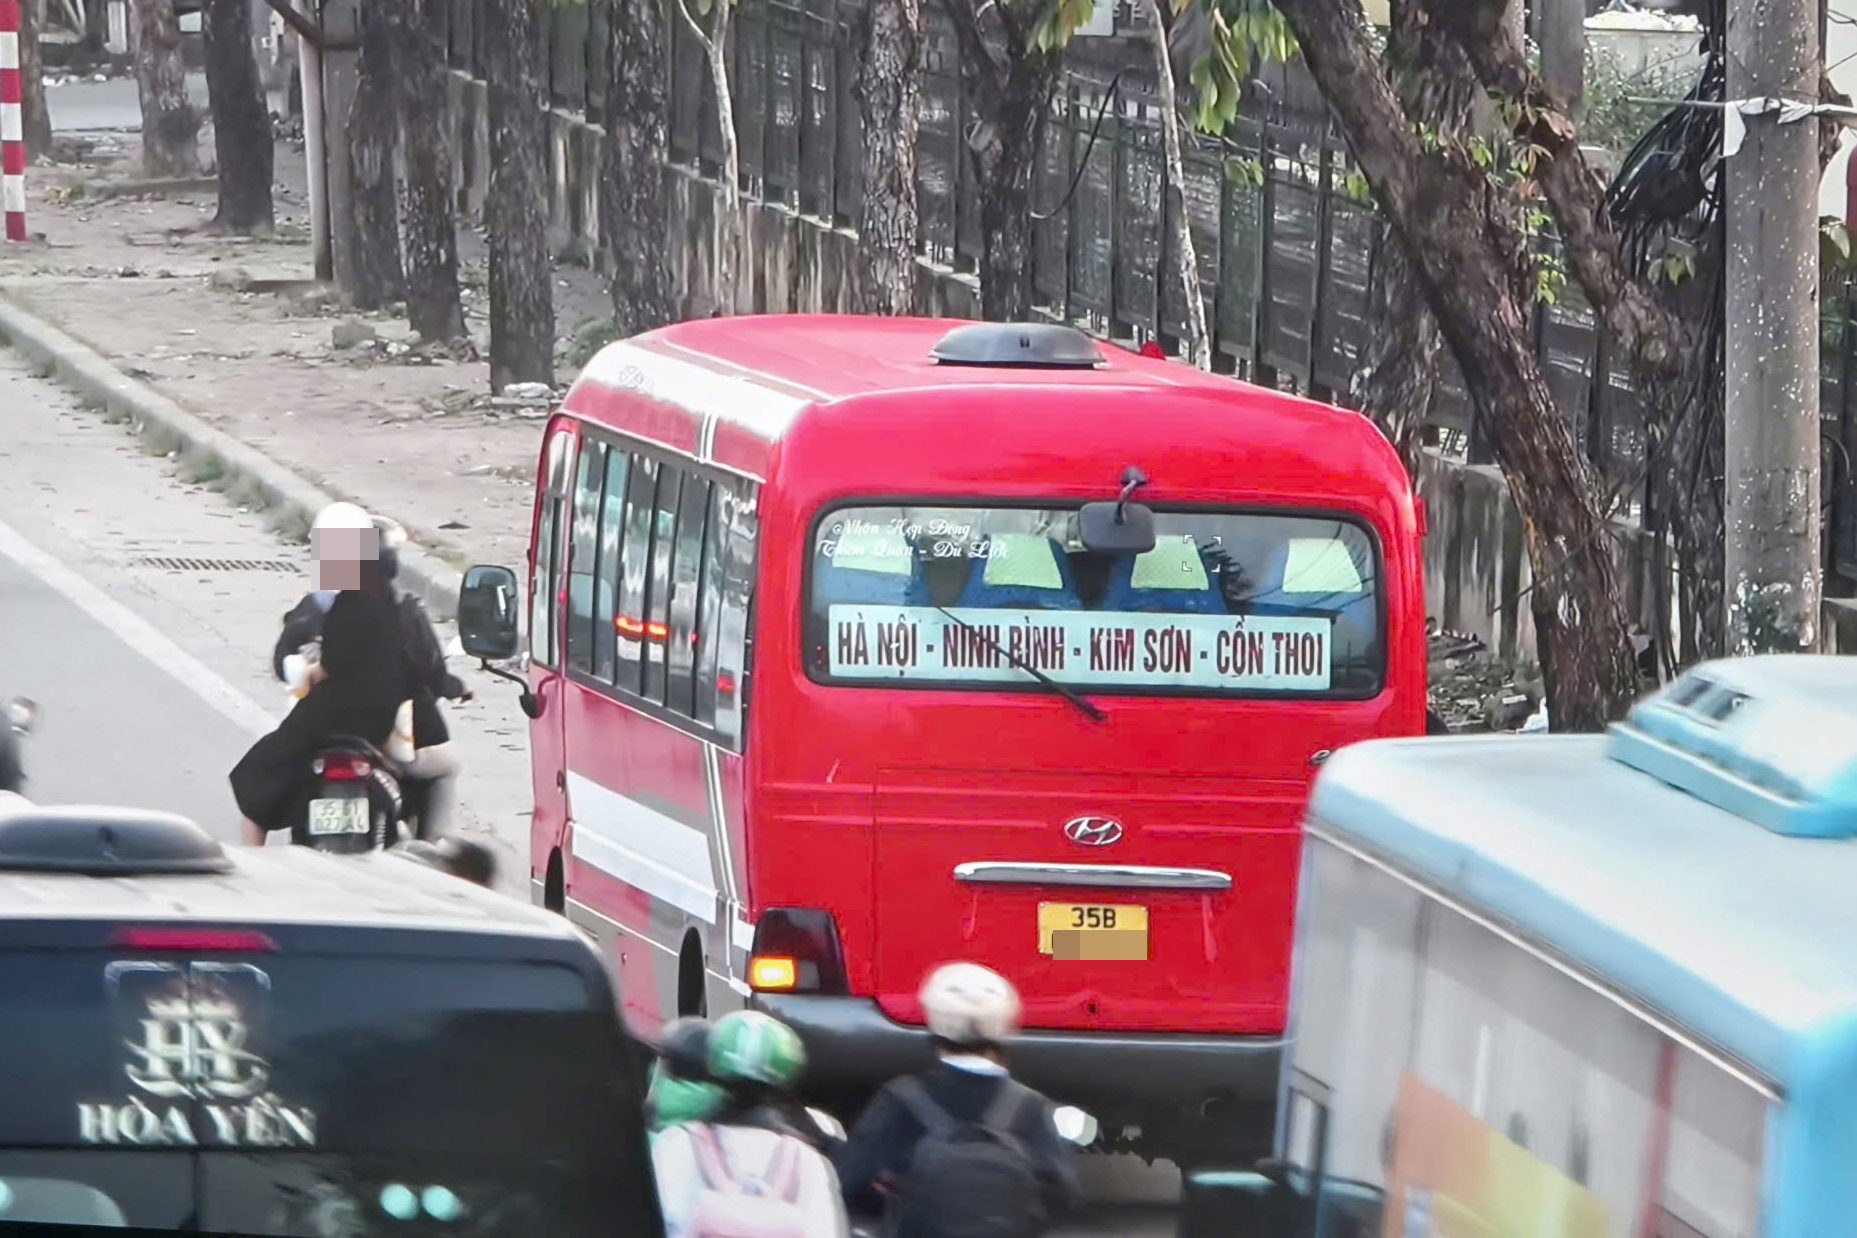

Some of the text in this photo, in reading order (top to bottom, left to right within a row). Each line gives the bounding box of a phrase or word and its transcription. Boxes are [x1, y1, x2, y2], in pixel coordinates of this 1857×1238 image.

[838, 612, 869, 666] HÀ
[877, 613, 917, 677] NỘI
[943, 623, 1000, 668] NINH
[1009, 616, 1065, 670] BÌNH
[1090, 627, 1135, 672] KIM
[1144, 625, 1192, 673] SƠN
[1272, 632, 1323, 676] THOI
[1071, 906, 1117, 929] 35B
